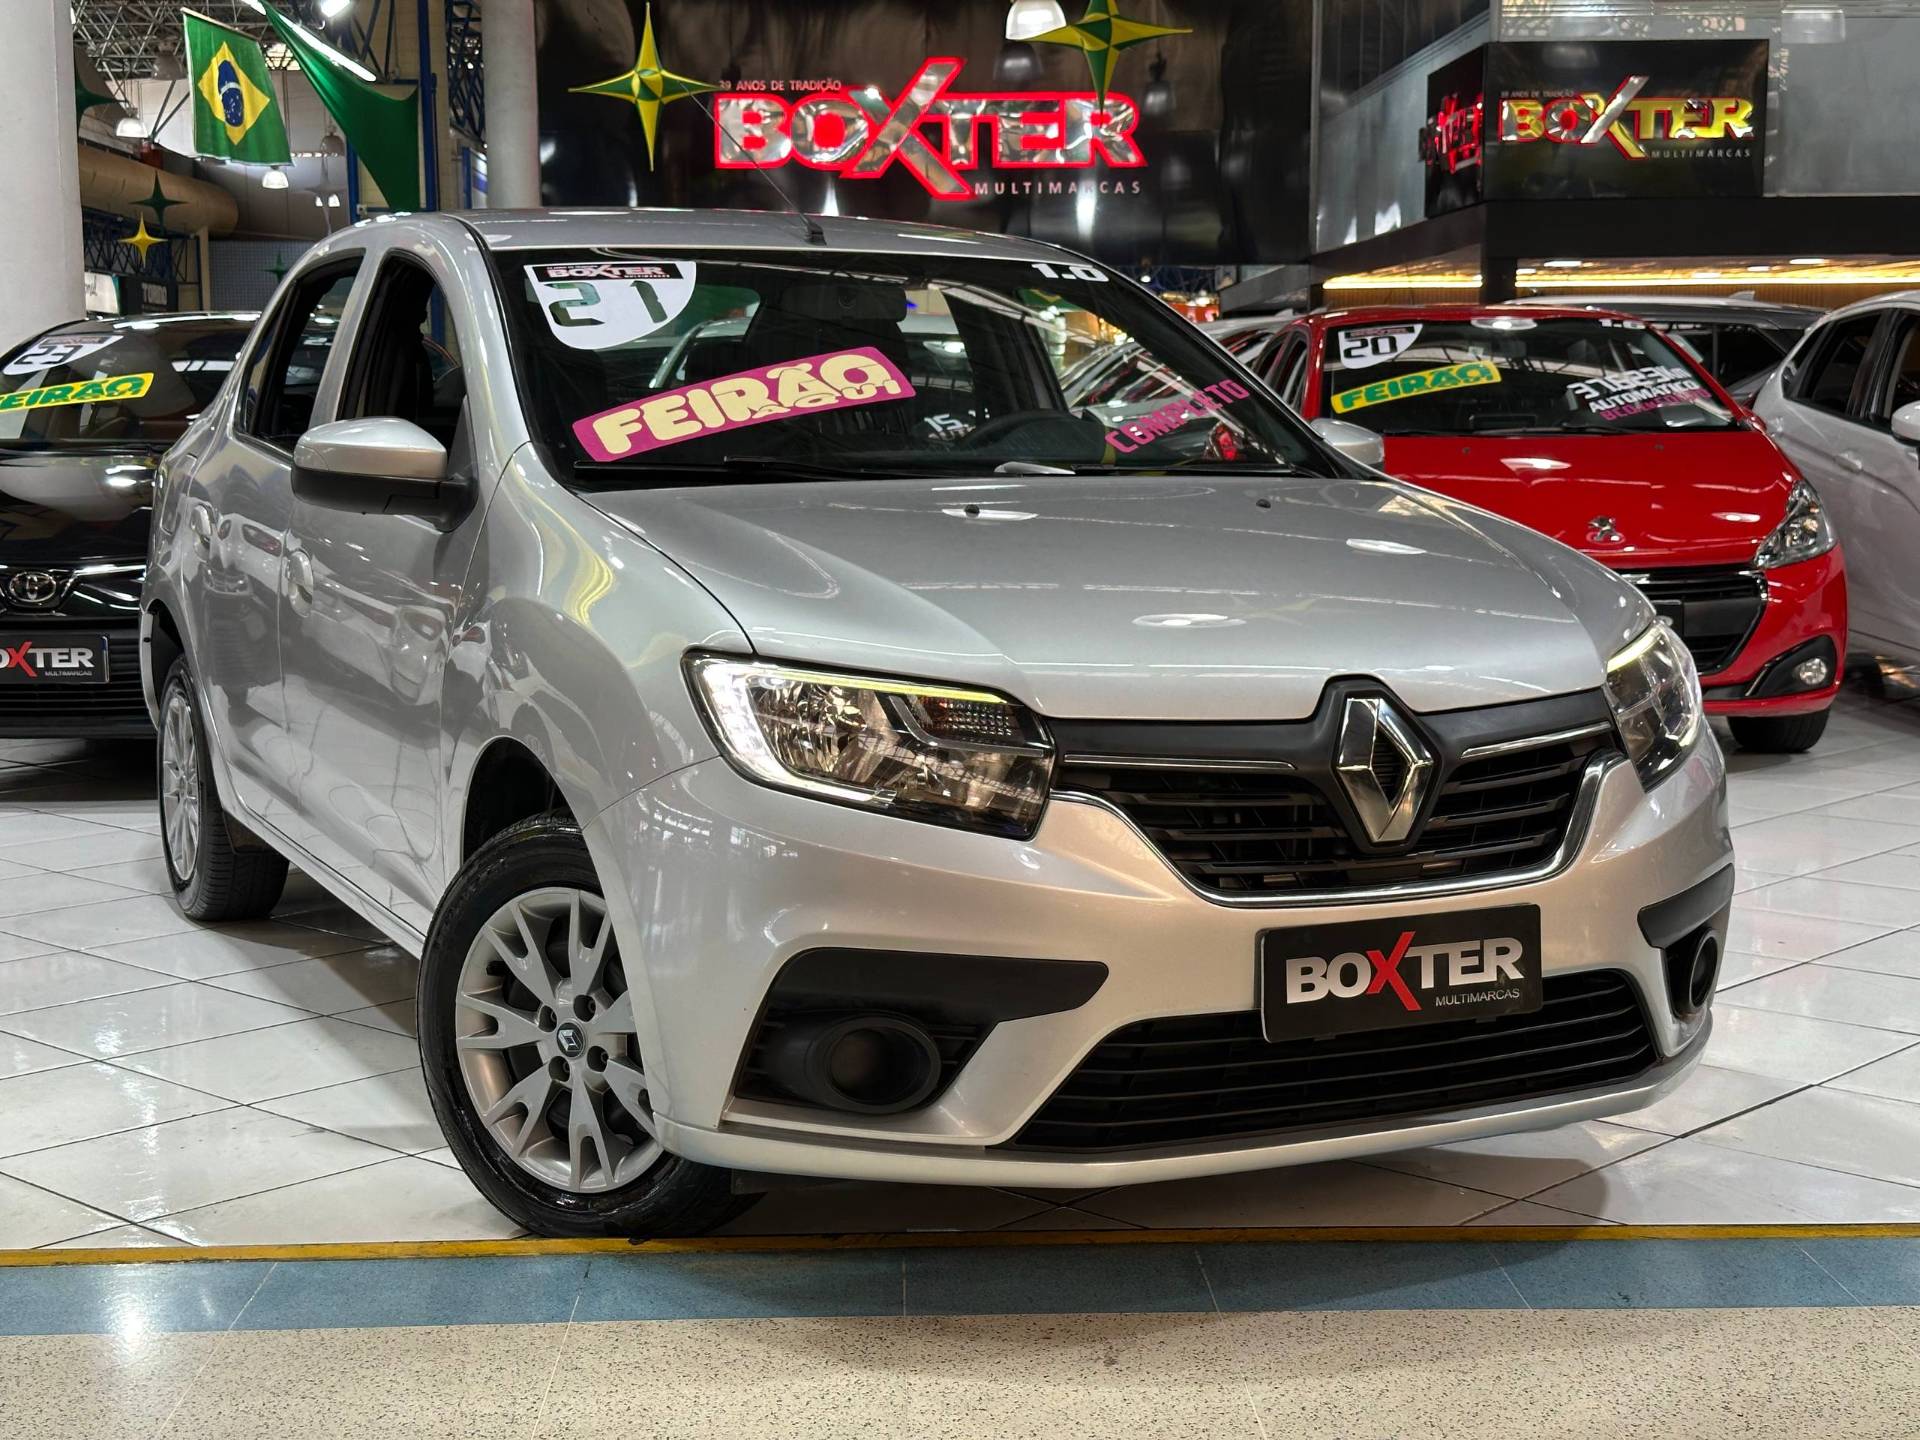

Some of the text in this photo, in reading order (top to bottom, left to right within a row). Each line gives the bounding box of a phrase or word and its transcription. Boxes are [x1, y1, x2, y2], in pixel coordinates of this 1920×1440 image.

[735, 80, 766, 91] ANOS
[771, 80, 785, 91] DE
[789, 78, 842, 93] TRADIÇÃO
[714, 57, 1147, 200] BOXTER
[1498, 74, 1755, 160] BOXTER
[1651, 149, 1752, 159] MULTIMARCAS
[974, 181, 1142, 196] MULTIMARCAS
[547, 264, 666, 279] BOXTER
[1031, 263, 1109, 282] 1.0
[543, 280, 668, 327] 21
[1343, 335, 1399, 359] 20
[0, 376, 145, 410] EIRÃO
[1340, 362, 1493, 409] FEIRÃO
[592, 354, 891, 454] FEIRÃO
[1104, 379, 1250, 453] COMPLETO
[0, 641, 95, 677] XTER
[1286, 931, 1524, 1011] BOXTER
[1435, 988, 1520, 1008] MULTIMARCAS
